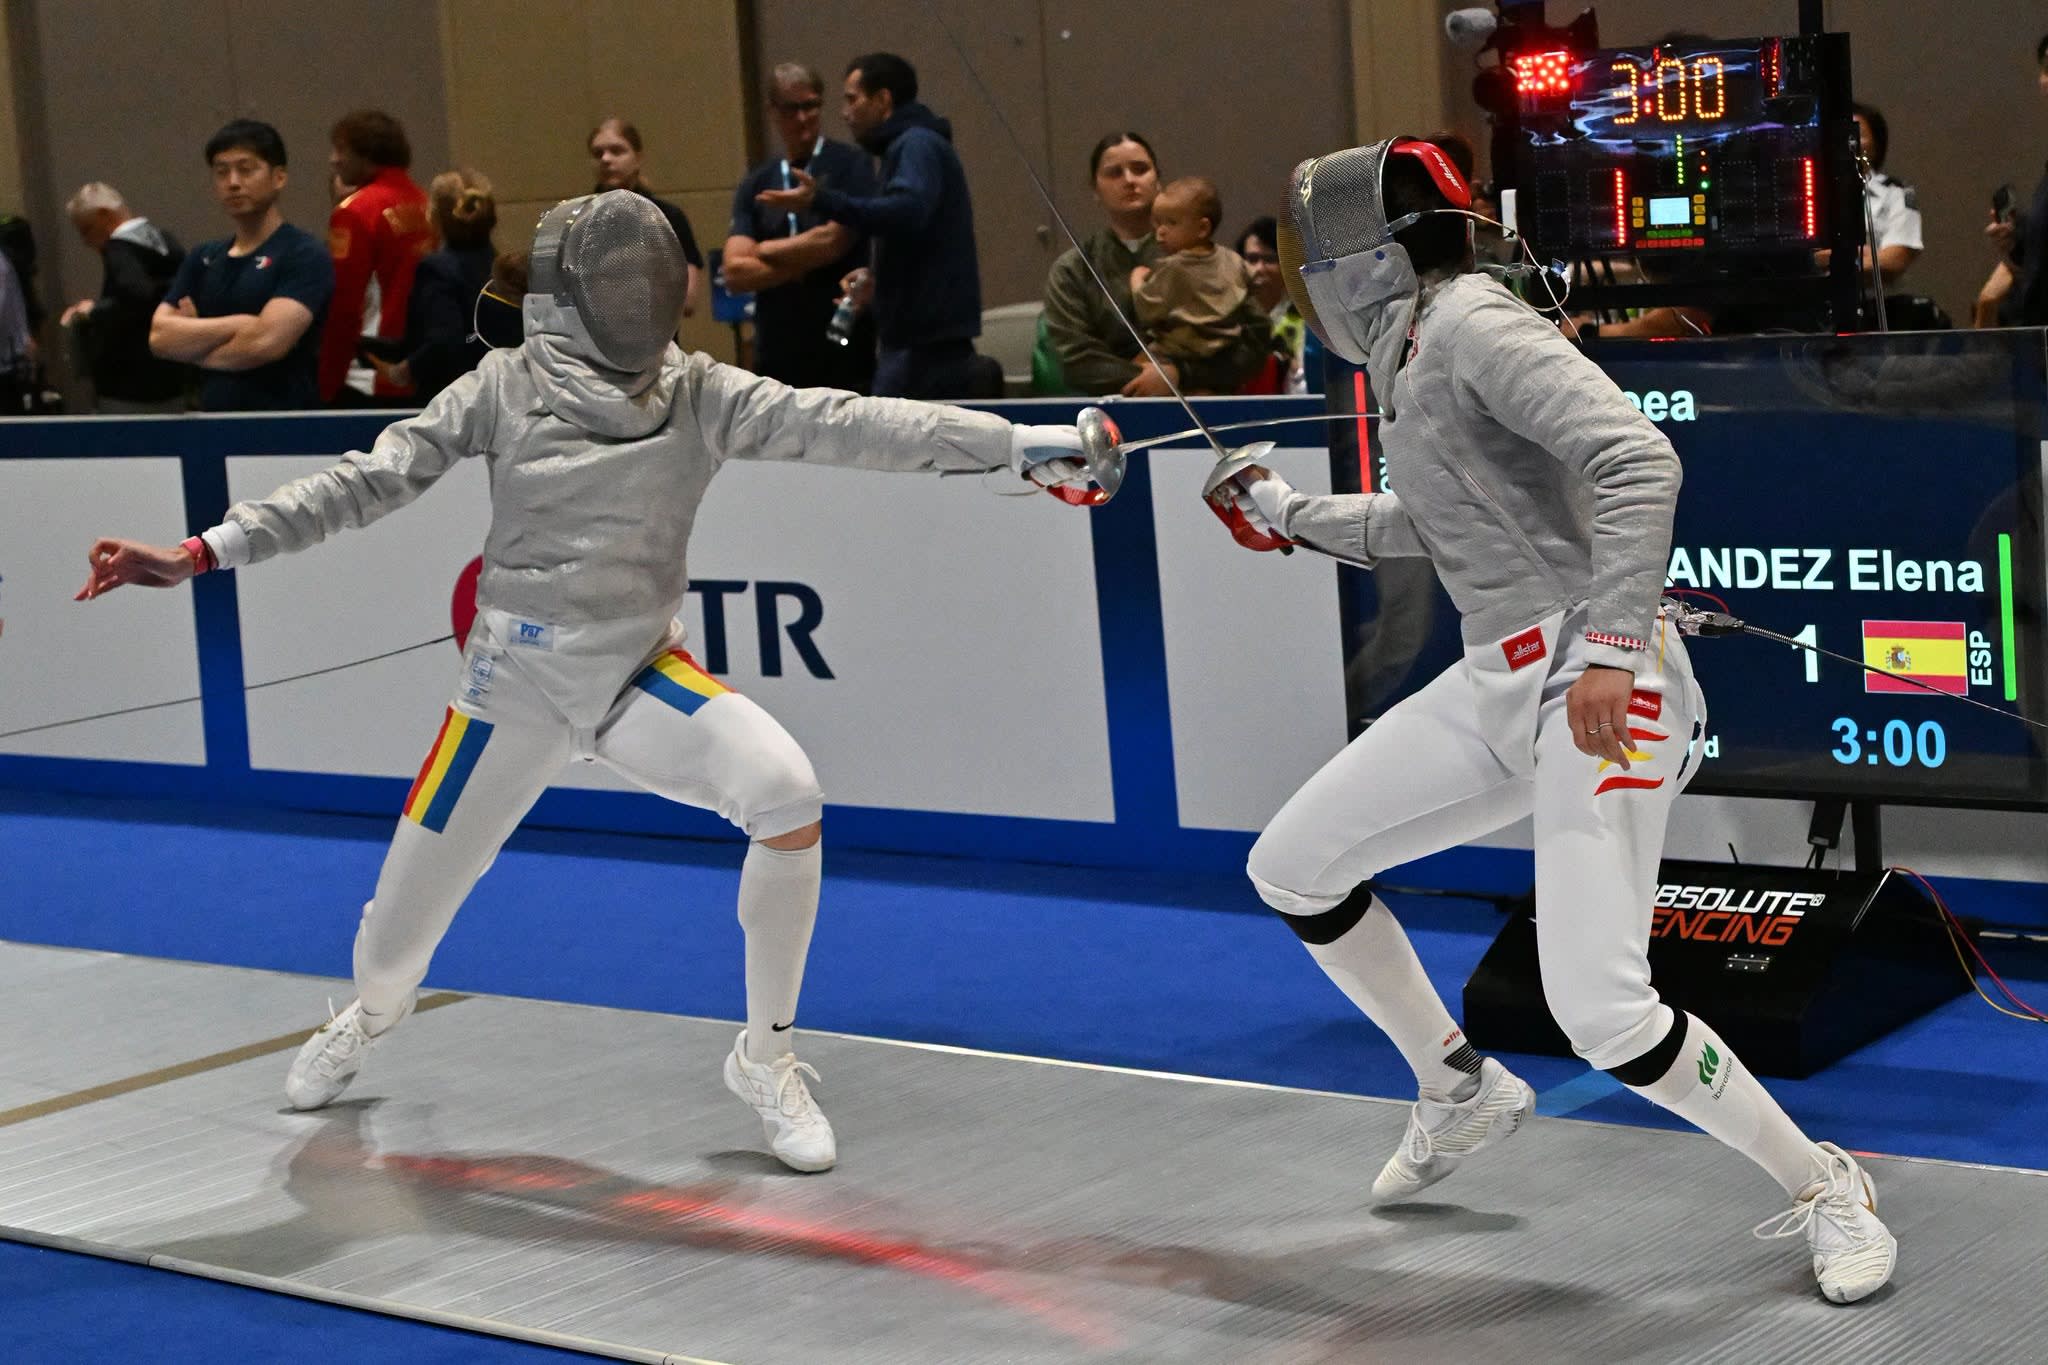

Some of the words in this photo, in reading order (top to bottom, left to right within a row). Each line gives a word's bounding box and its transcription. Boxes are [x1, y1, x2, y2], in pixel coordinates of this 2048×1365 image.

[1611, 56, 1726, 124] 3:00
[1664, 547, 1834, 590] ANDEZ
[1848, 549, 1985, 593] Elena
[1791, 624, 1820, 683] 1
[1969, 630, 1993, 686] ESP
[1831, 717, 1947, 769] 3:00
